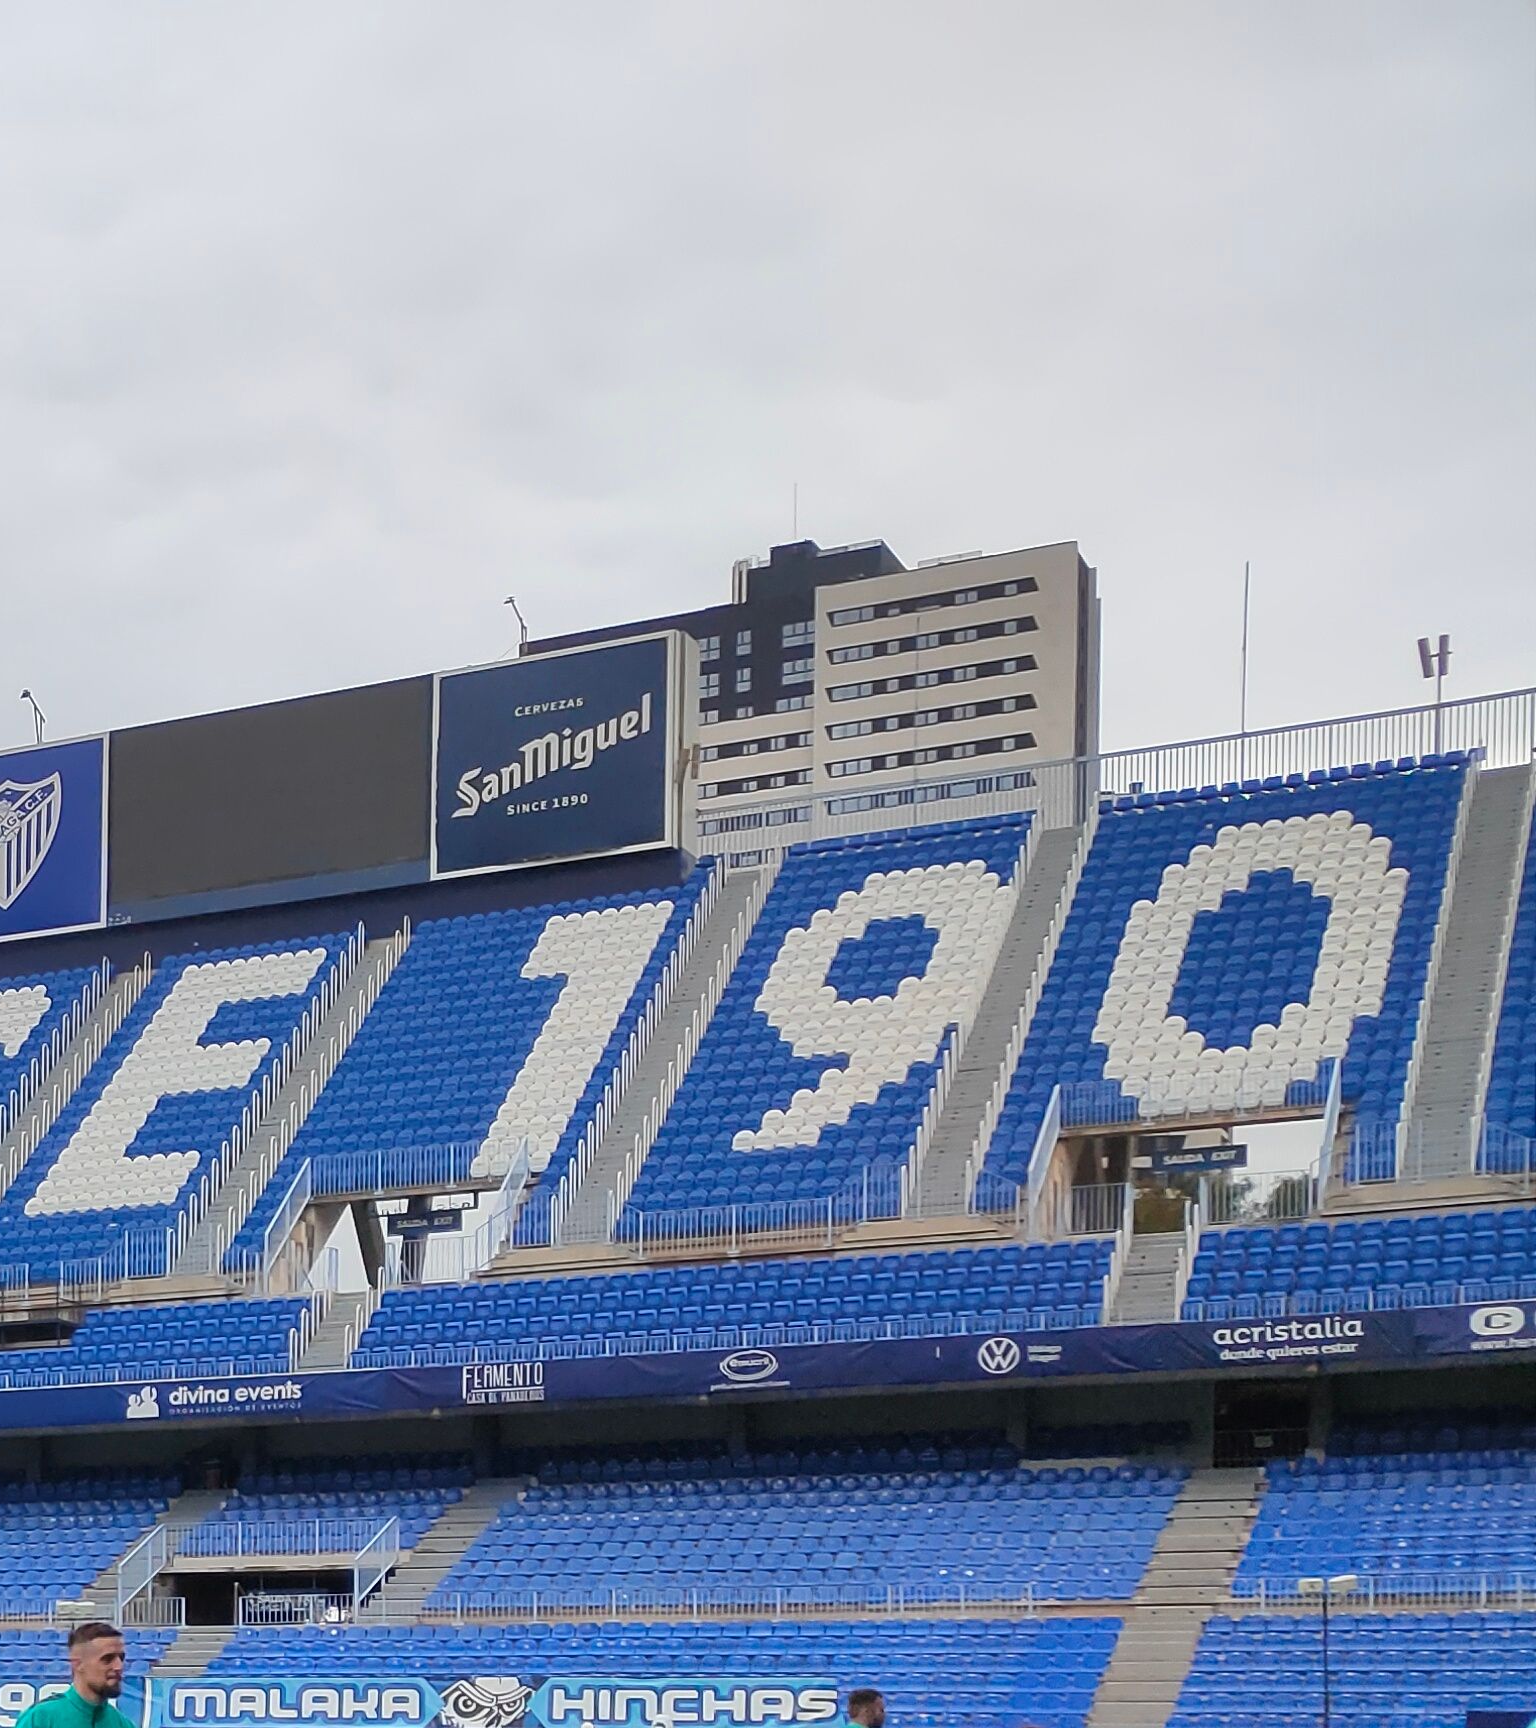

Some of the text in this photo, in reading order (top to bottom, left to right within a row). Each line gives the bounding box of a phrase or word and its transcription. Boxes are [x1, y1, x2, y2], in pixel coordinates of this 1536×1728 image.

[514, 697, 585, 718] CERVEZAS
[506, 793, 589, 817] SINCE 1890
[1212, 1315, 1365, 1346] acristalia
[168, 1379, 302, 1406] divina events
[462, 1362, 544, 1400] FERMENTO
[172, 1688, 422, 1720] MALAKA
[551, 1687, 839, 1721] HINCHAS
